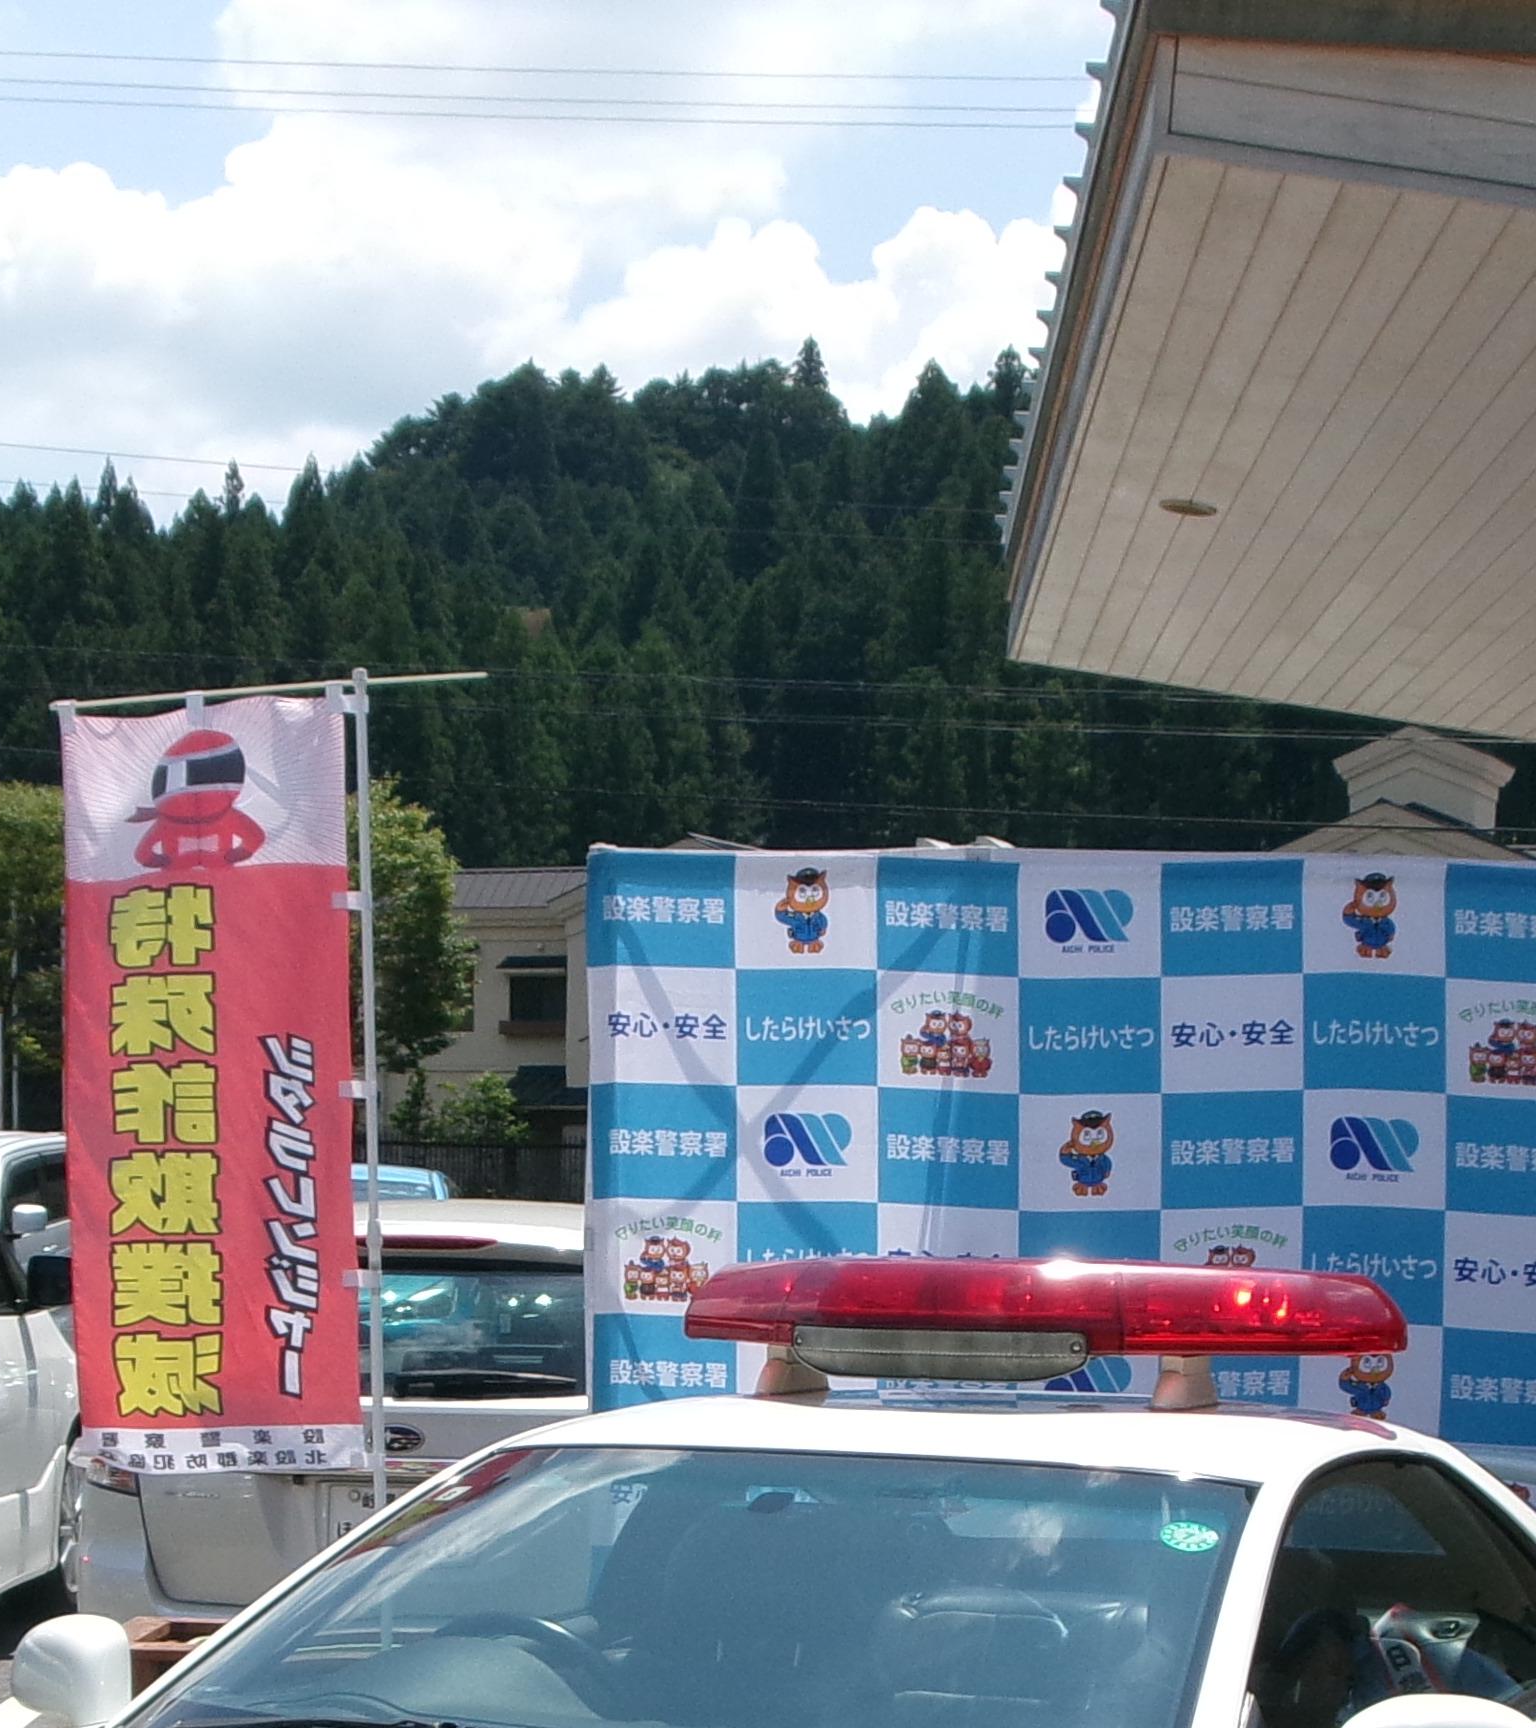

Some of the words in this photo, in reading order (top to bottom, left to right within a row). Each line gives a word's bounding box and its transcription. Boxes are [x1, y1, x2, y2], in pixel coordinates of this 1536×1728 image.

[603, 895, 726, 924] 設楽警察署
[885, 901, 1009, 933] 設楽警察署
[1170, 904, 1294, 932] 設楽警察署
[890, 990, 1005, 1019] 守りたい笑顔の絆
[607, 1011, 727, 1040] 安心・安全
[745, 1015, 871, 1041] したらけいさつ
[1028, 1024, 1155, 1051] したらけいさつ
[1170, 1019, 1295, 1048] 安心・安全
[1312, 1019, 1440, 1047] したらけいさつ
[609, 1129, 728, 1157] 設楽警察署
[886, 1133, 1009, 1165] 設楽警察署
[1170, 1137, 1295, 1165] 設楽警察署
[614, 1216, 723, 1243] 守りたい笑顔の絆
[1173, 1224, 1289, 1252] 守りたい笑顔の絆
[609, 1359, 728, 1389] 設楽警察署
